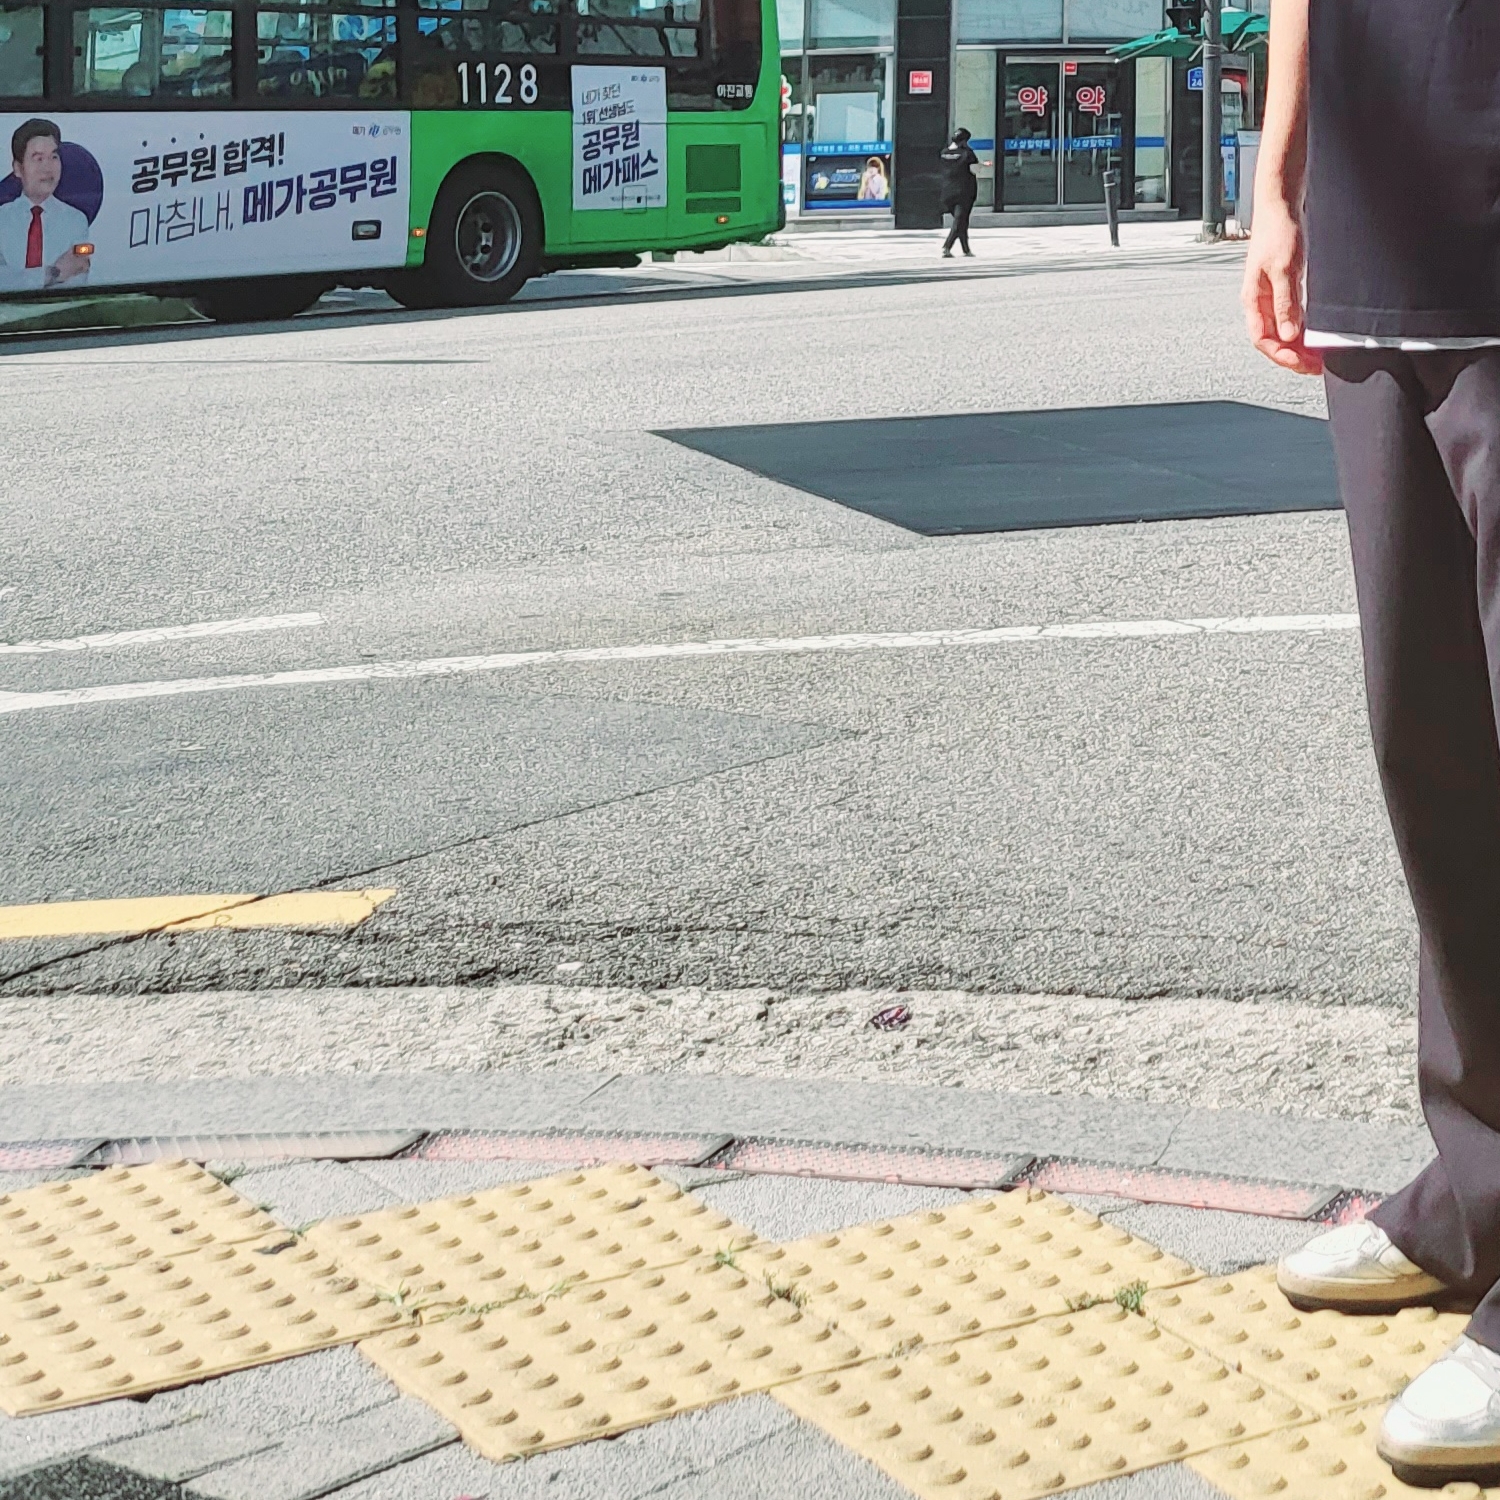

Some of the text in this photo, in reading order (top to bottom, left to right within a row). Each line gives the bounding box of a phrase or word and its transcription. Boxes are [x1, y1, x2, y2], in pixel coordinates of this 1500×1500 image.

[457, 61, 539, 104] 1128
[1017, 85, 1049, 117] 약
[1075, 85, 1106, 117] 약
[582, 119, 641, 162] 공무원
[131, 131, 286, 194] 공무원 합격!
[582, 149, 659, 196] 메가패스
[129, 156, 398, 249] 마침내, 메가공무원
